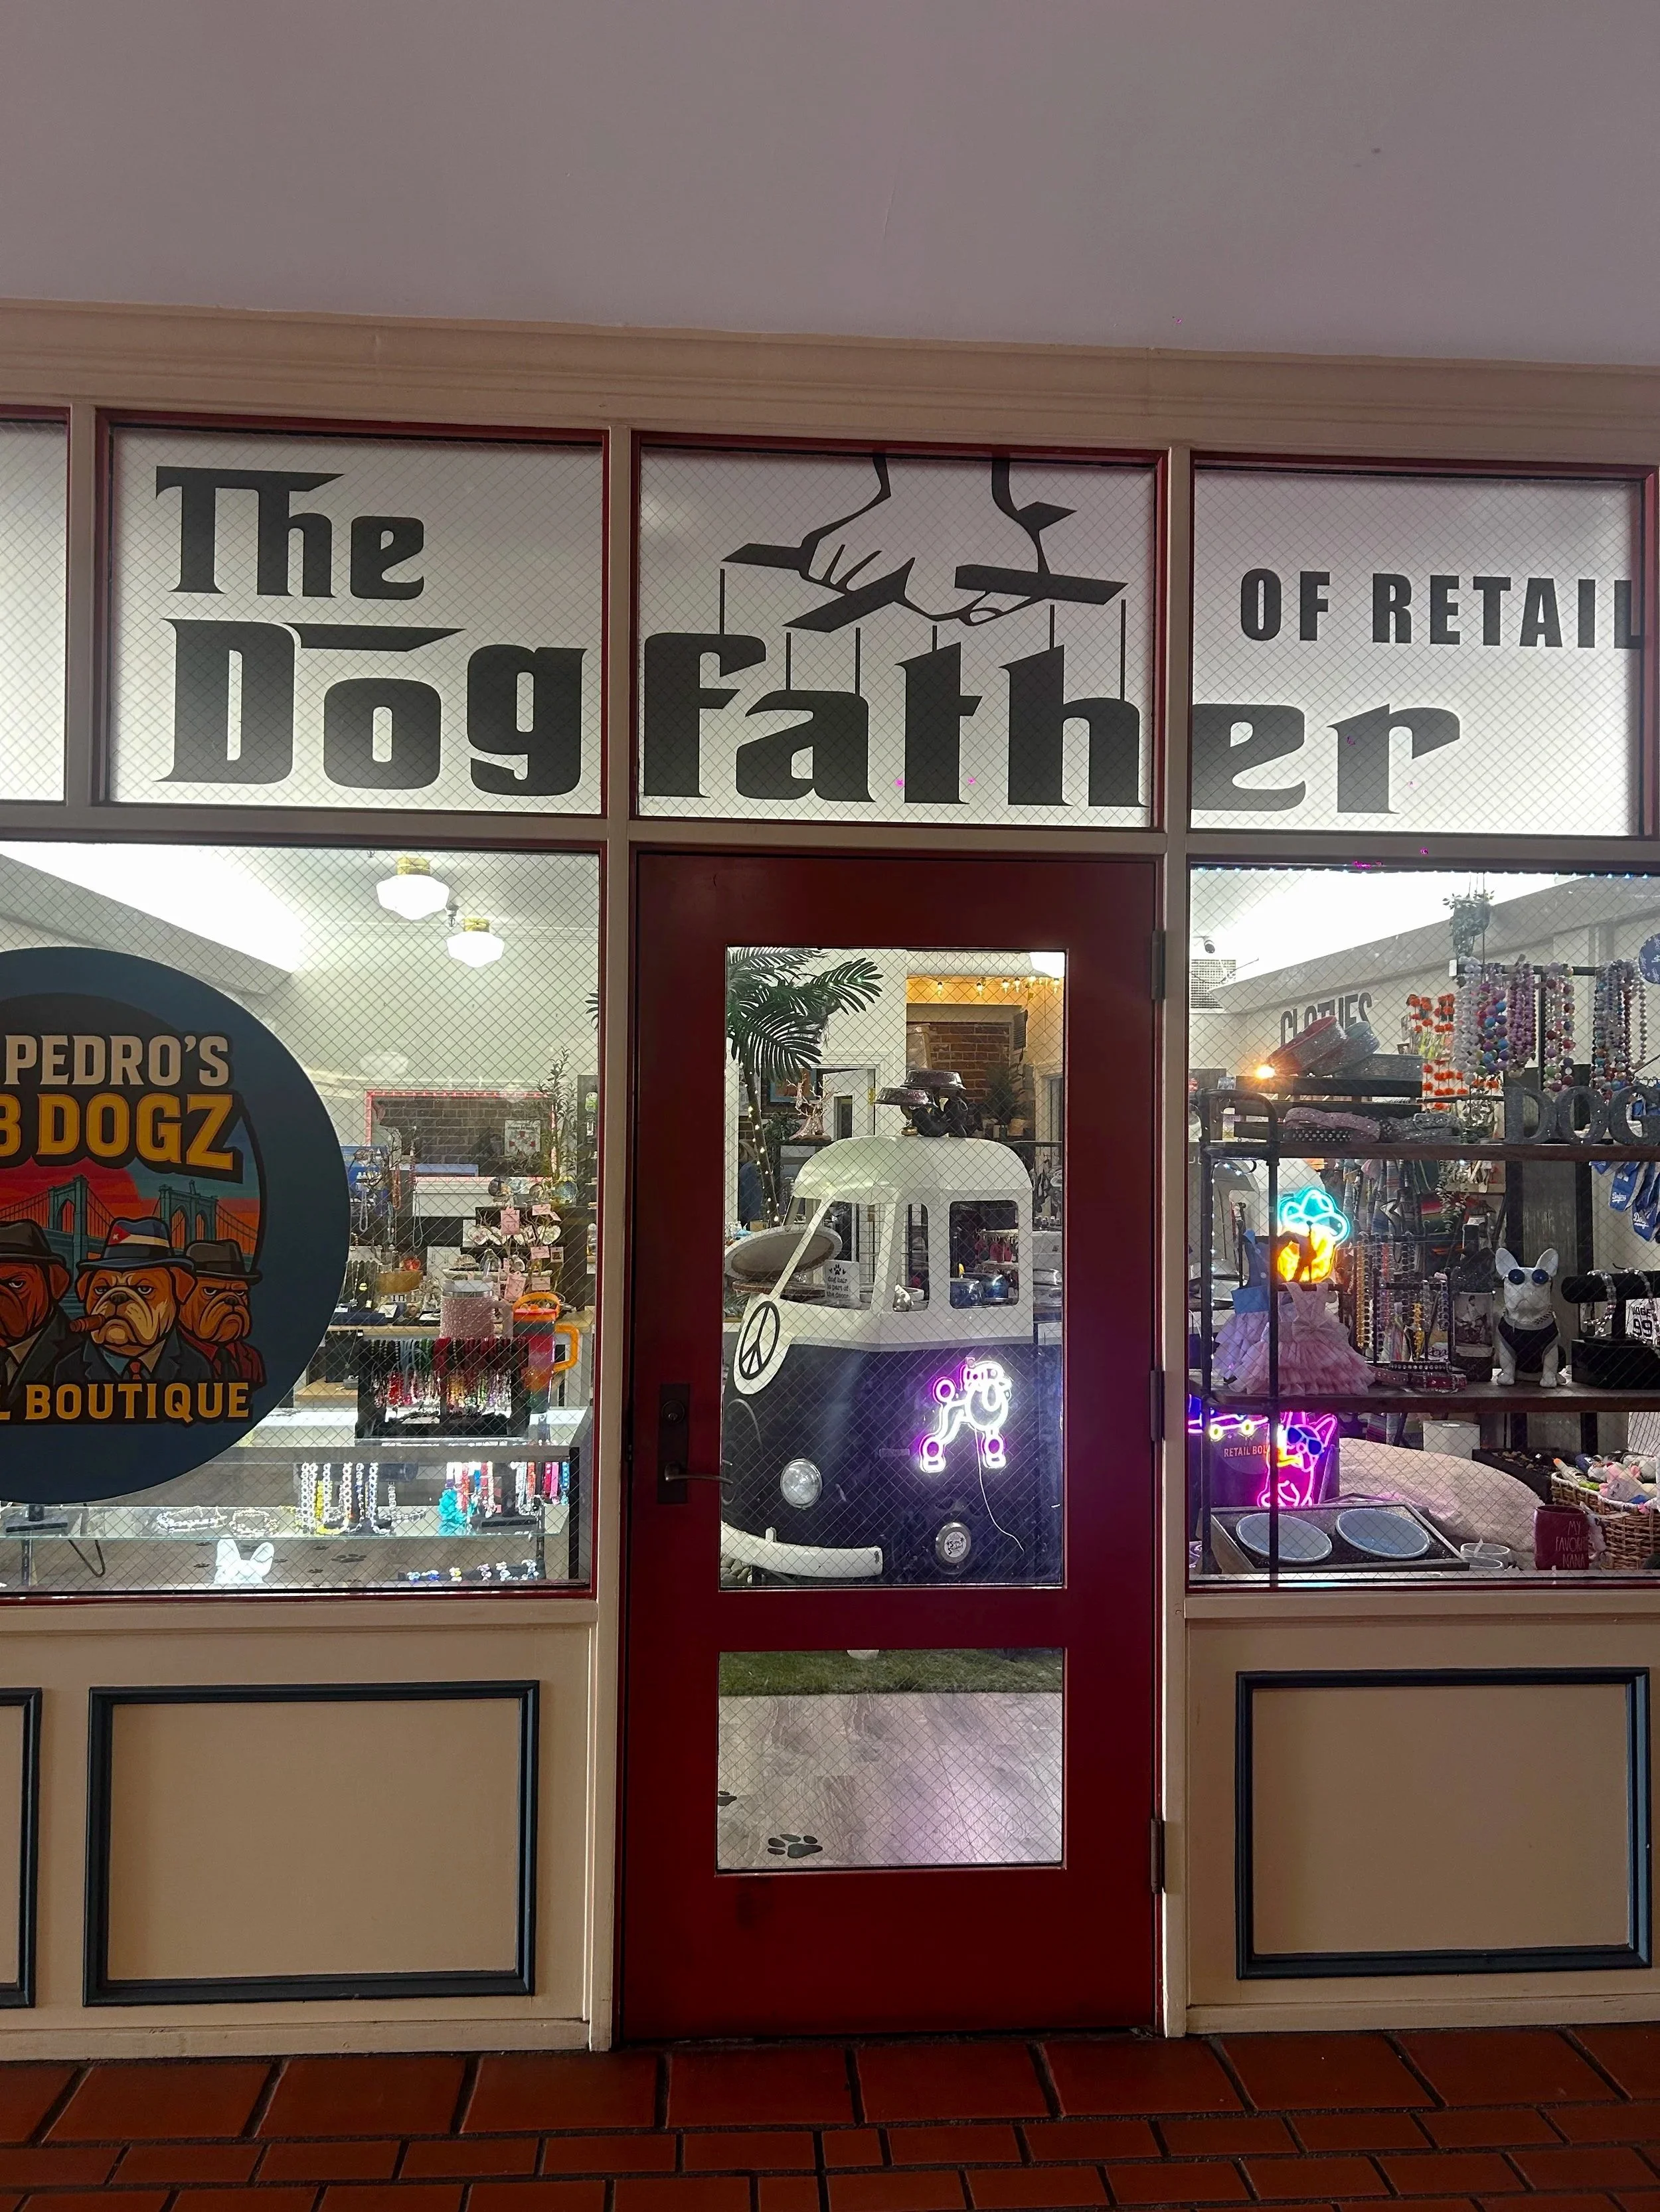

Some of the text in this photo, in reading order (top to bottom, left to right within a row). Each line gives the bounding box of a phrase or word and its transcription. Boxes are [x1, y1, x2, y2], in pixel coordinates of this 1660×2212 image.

[156, 465, 424, 600] The
[1240, 568, 1645, 649] OF RETAIL
[4, 1034, 230, 1087] PEDRO'S
[36, 1092, 234, 1171] DOGZ
[1633, 1318, 1653, 1338] 99
[25, 1382, 250, 1423] BOUTIQUE
[1224, 1447, 1250, 1457] RETAIL
[1567, 1520, 1581, 1536] MY
[1562, 1553, 1586, 1569] NANA
